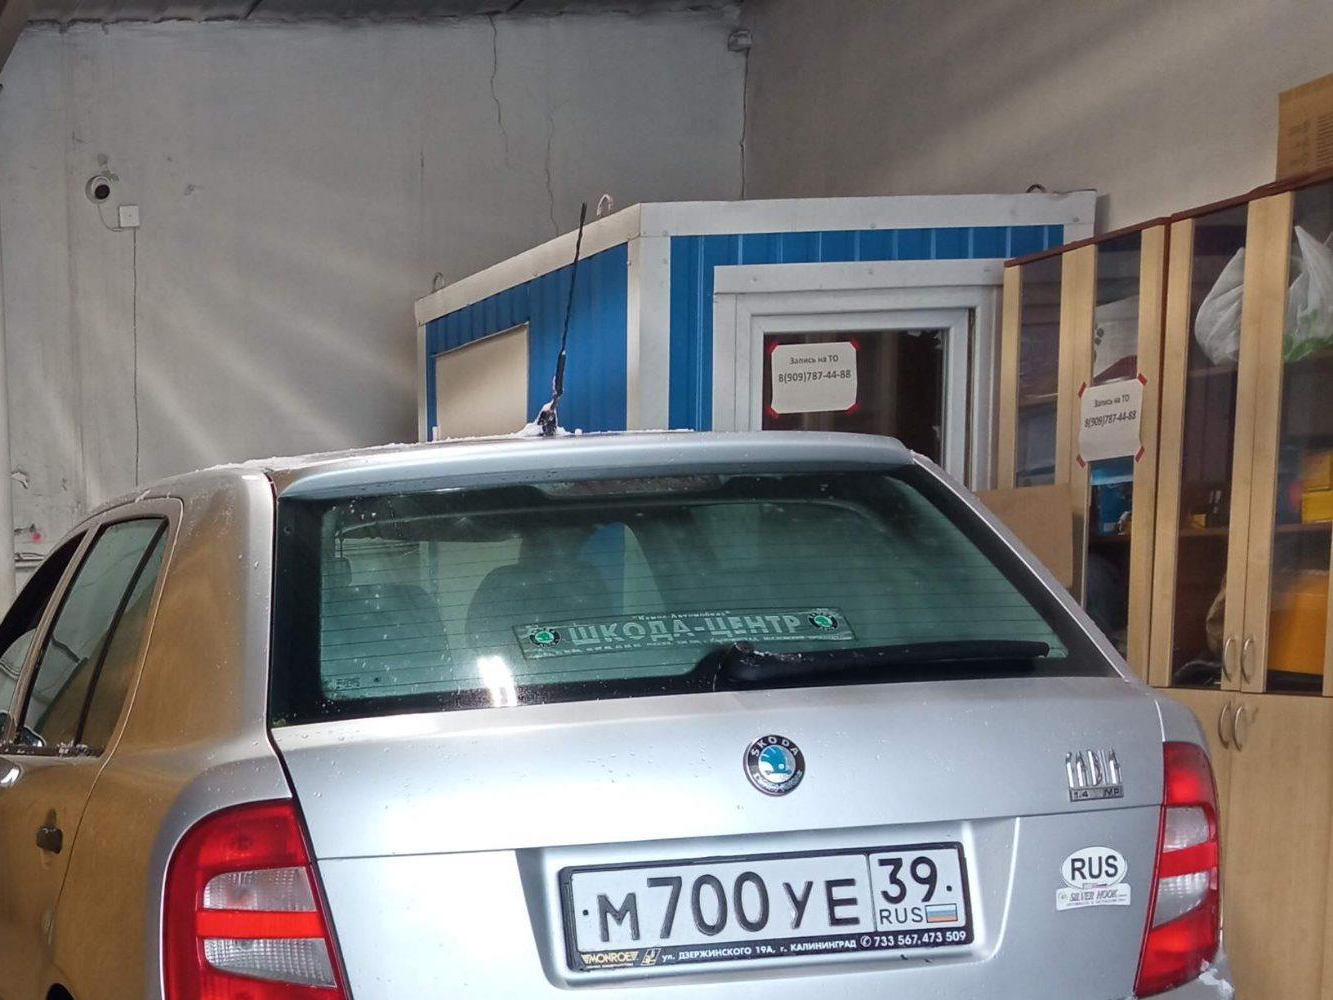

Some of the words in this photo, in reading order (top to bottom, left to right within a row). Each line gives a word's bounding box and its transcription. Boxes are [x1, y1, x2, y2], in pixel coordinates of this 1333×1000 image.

[789, 356, 817, 365] Запись
[827, 354, 839, 362] ТО
[778, 369, 851, 384] 8(909)787-44-88
[568, 614, 802, 646] ШКОДА-ЦЕНТР
[1070, 855, 1118, 881] RUS
[878, 856, 938, 904] 39
[879, 905, 923, 925] RUS
[662, 954, 675, 962] ул.
[679, 947, 751, 960] ДЗЕРЖИНСКОГО
[790, 940, 856, 952] КАЛИНИНГРАД
[874, 936, 894, 947] 733
[946, 930, 966, 942] 509
[583, 951, 637, 965] MONROE
